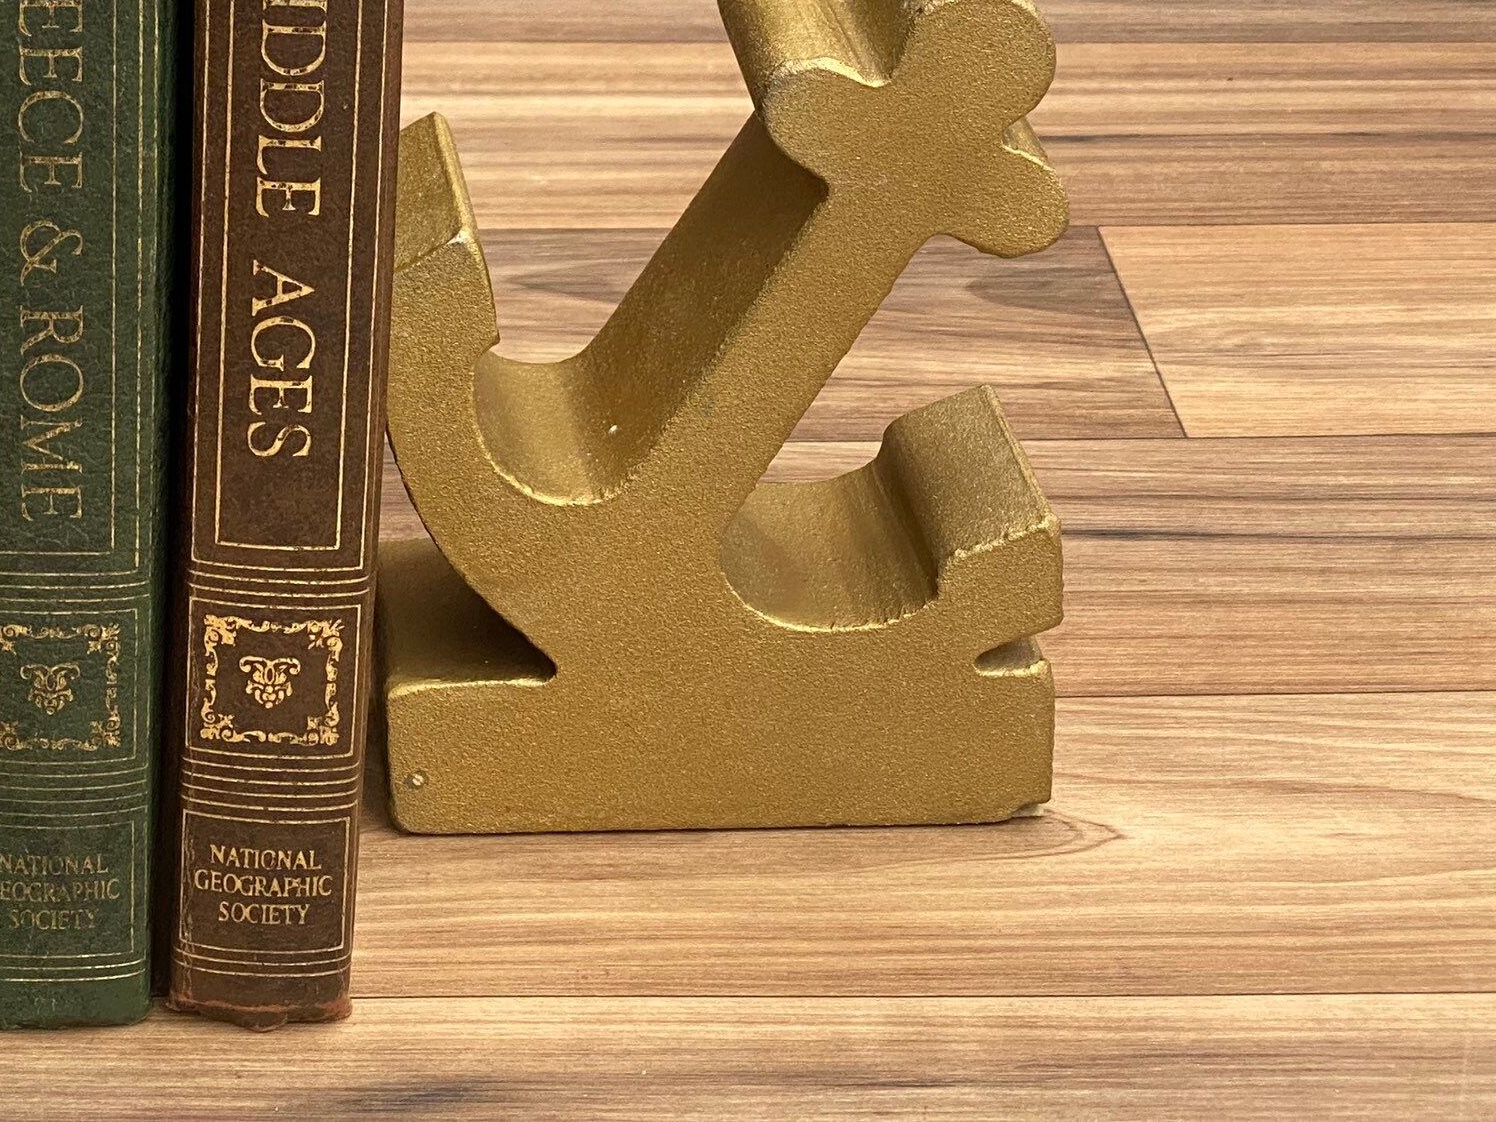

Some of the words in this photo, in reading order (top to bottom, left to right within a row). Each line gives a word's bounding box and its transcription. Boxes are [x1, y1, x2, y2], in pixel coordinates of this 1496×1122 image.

[18, 219, 84, 284] &
[246, 258, 318, 459] AGES
[18, 303, 84, 523] ROME
[208, 843, 323, 871] NATIONAL
[193, 869, 334, 897] GEOGRAPHIC
[7, 907, 100, 931] SOCIETY
[217, 900, 312, 925] SOCIETY
